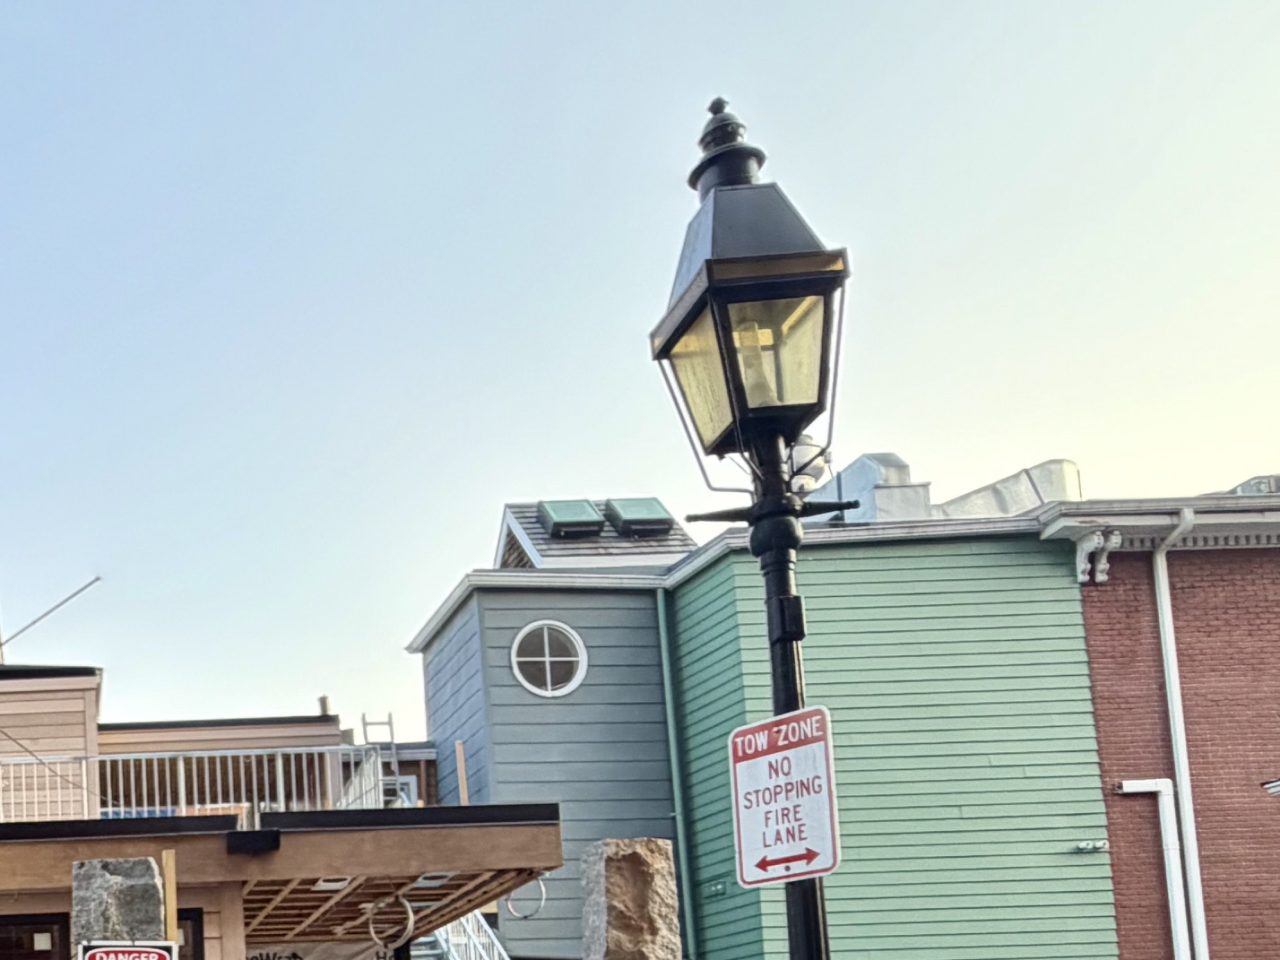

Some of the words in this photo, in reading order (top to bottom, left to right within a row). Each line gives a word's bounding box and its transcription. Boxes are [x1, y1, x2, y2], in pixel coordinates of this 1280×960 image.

[734, 729, 769, 757] TOW
[776, 715, 824, 746] ZONE
[767, 756, 792, 779] NO
[743, 775, 823, 810] STOPPING
[764, 804, 803, 828] FIRE
[762, 823, 808, 848] LANE
